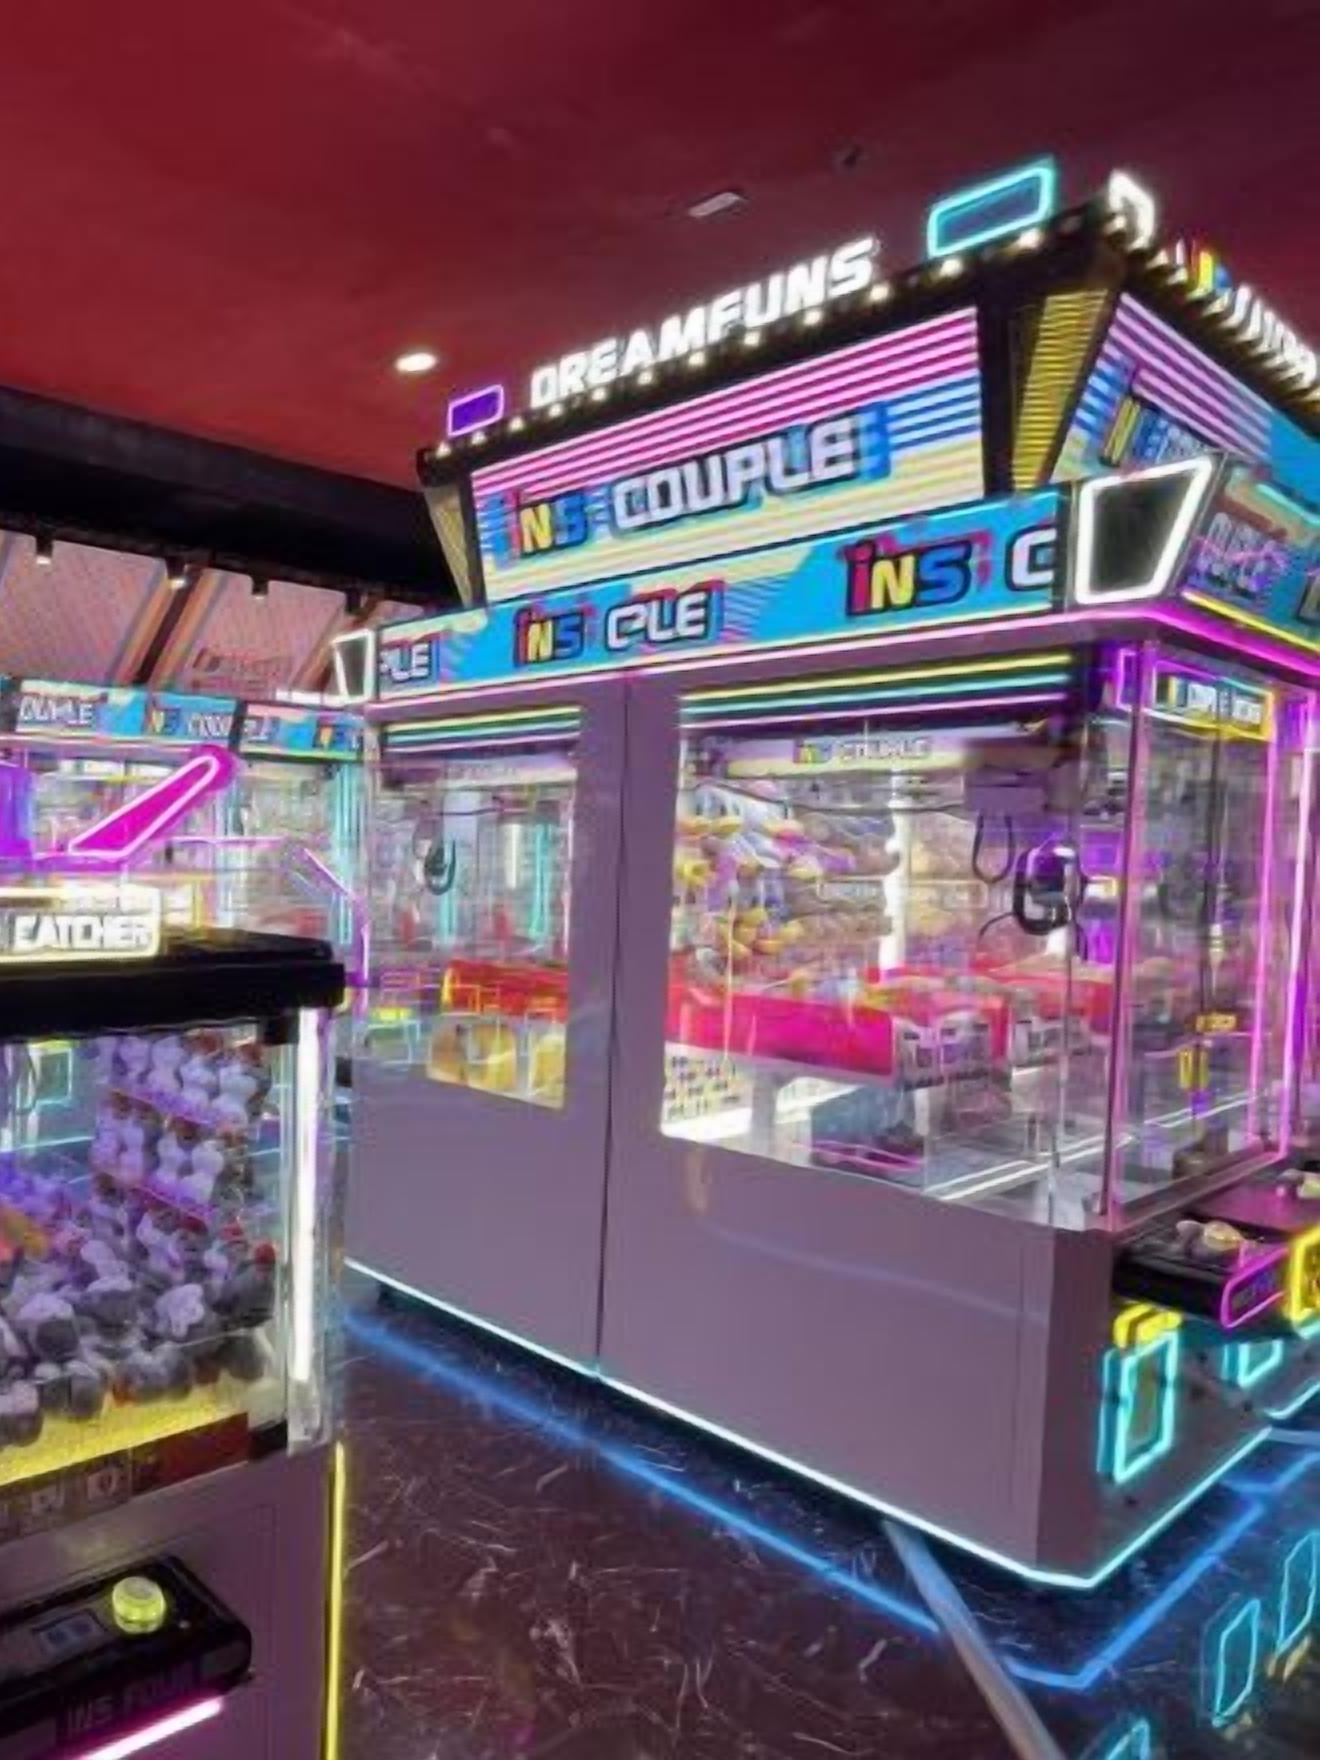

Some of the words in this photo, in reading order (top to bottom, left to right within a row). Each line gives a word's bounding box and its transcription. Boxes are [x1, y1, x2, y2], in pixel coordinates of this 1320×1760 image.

[530, 236, 876, 409] DREAMFUNS
[613, 413, 858, 532] COUPLE
[13, 913, 153, 951] CATCHER
